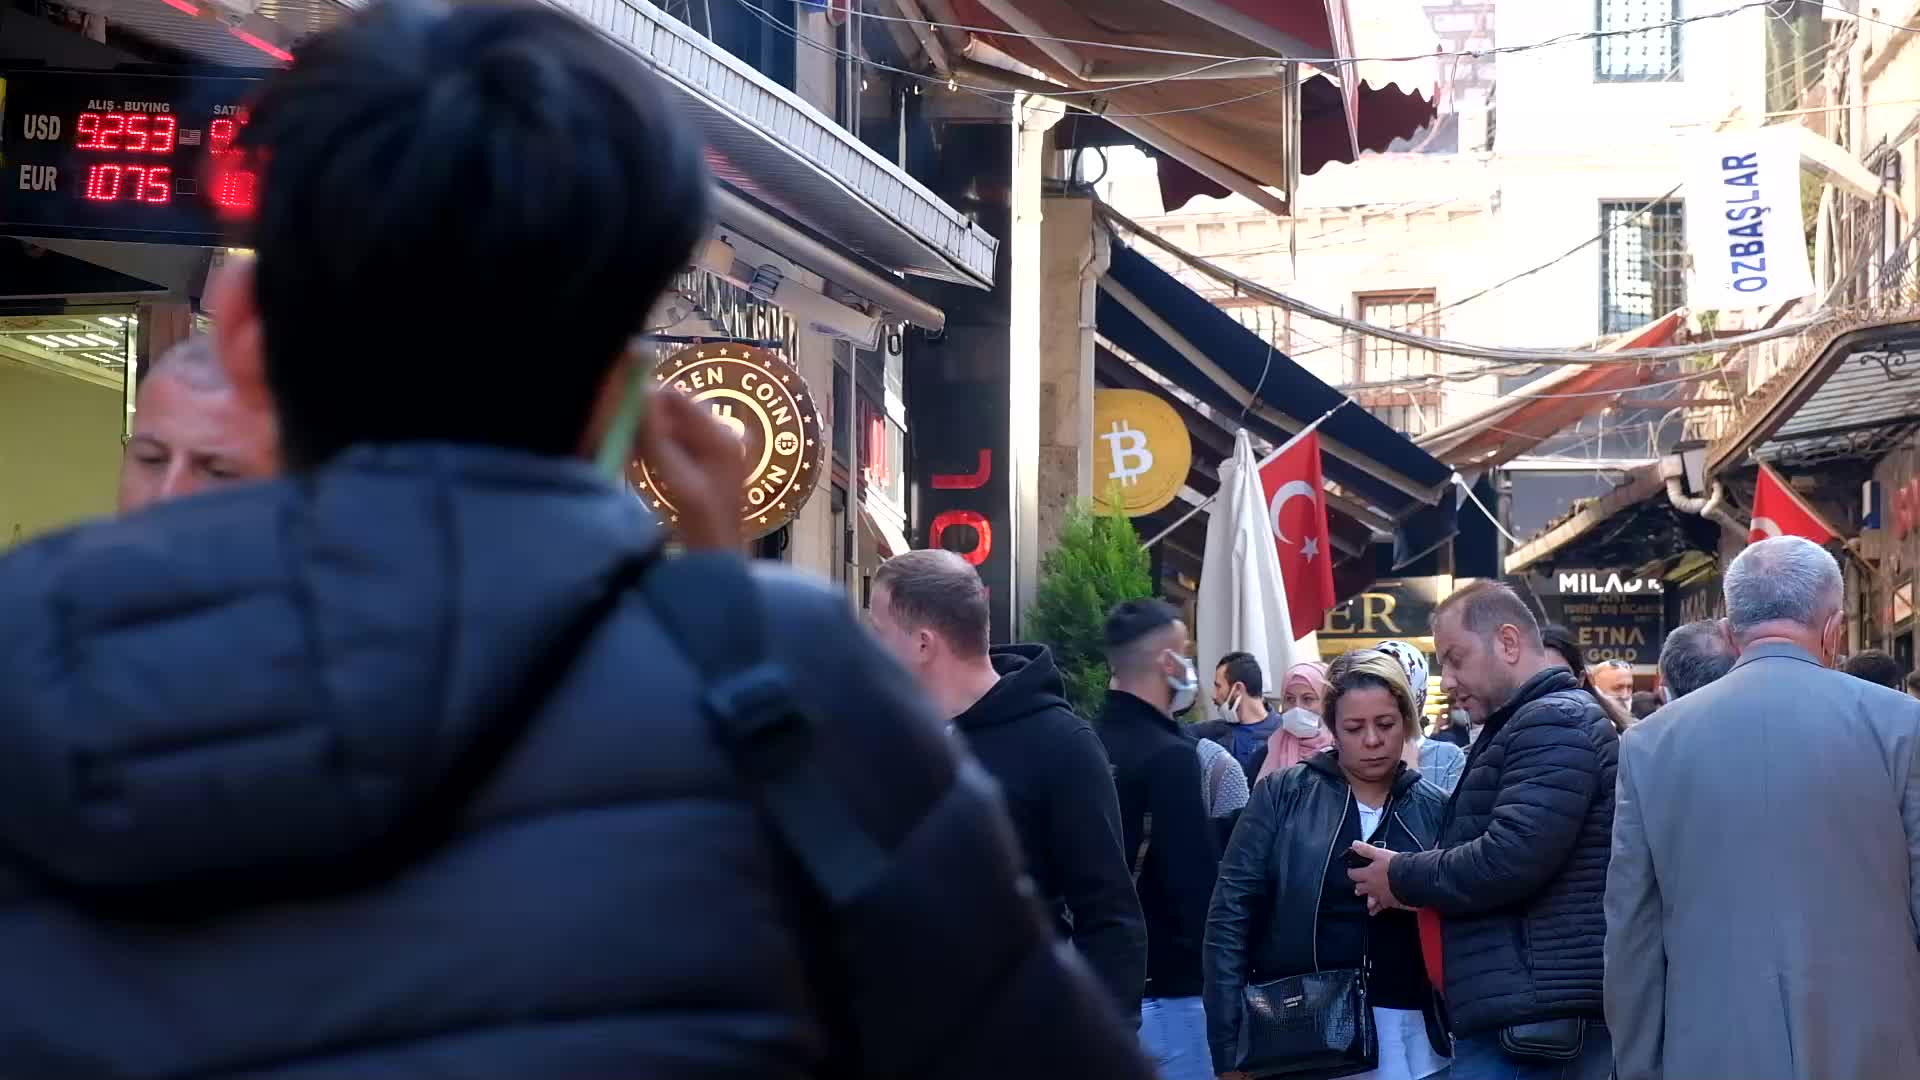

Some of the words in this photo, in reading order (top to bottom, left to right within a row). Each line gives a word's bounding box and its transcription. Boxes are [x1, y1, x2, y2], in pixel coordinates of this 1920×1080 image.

[87, 99, 115, 112] ALIŞ
[124, 101, 170, 113] BUYING
[24, 114, 61, 140] USD
[19, 164, 57, 191] EUR
[673, 366, 724, 396] REN
[929, 448, 993, 566] OL
[1317, 592, 1403, 634] ER
[1579, 626, 1645, 645] ETNA
[1588, 648, 1638, 661] GOLD
